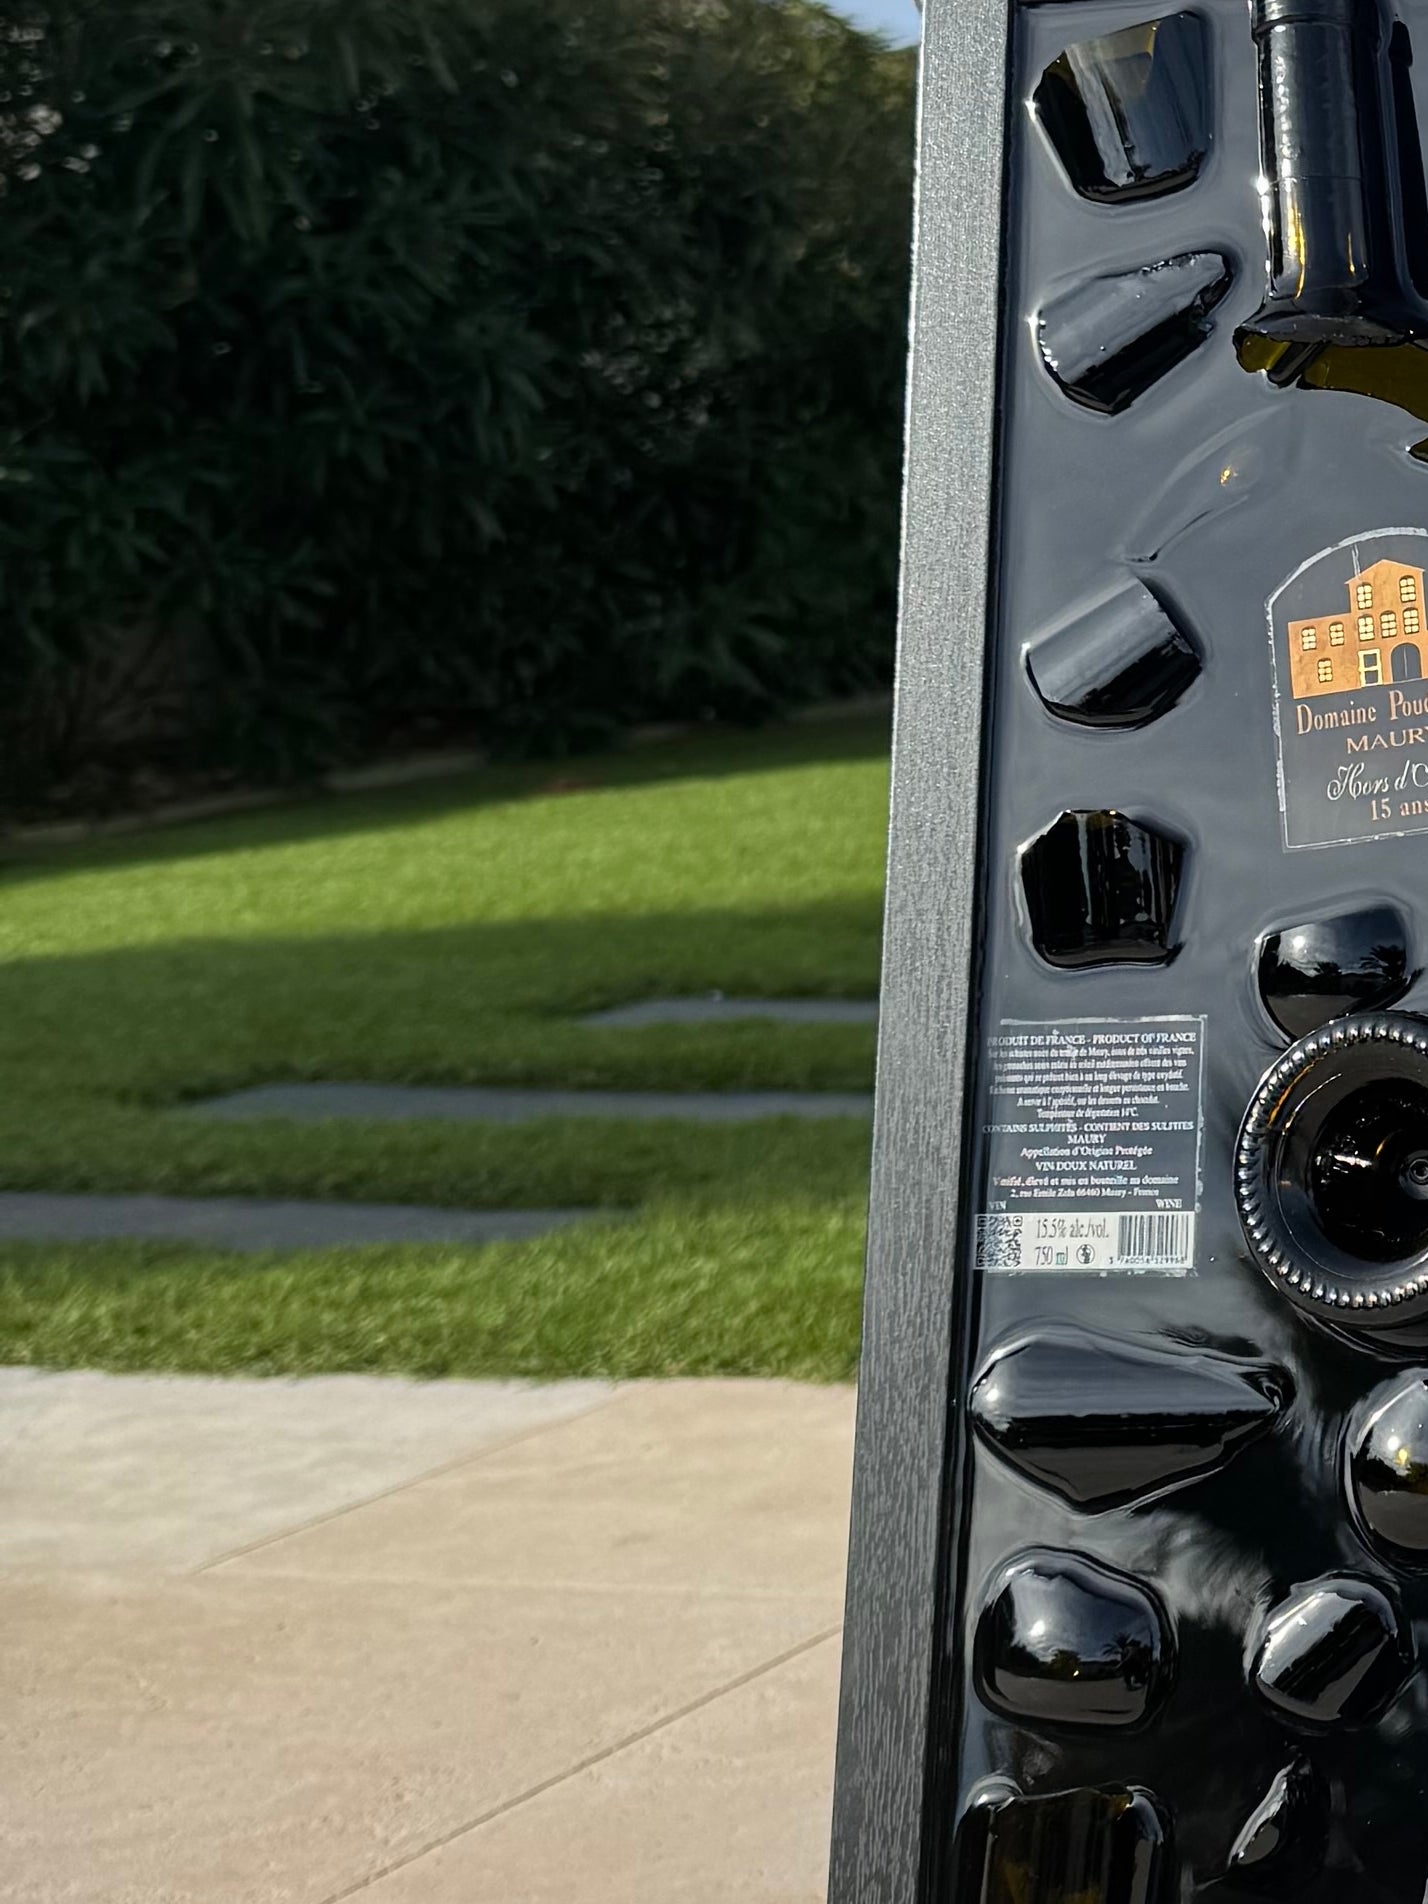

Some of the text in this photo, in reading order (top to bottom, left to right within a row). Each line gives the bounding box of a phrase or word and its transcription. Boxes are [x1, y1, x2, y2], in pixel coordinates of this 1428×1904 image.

[1296, 701, 1377, 735] Domaine
[1327, 763, 1389, 801] Hors
[1371, 799, 1392, 821] 15
[1031, 1035, 1044, 1045] DE
[1046, 1034, 1085, 1045] FRANCE
[1093, 1034, 1140, 1044] PRODUCT
[1156, 1032, 1196, 1042] FRANCE
[1084, 1122, 1130, 1131] CONTIENT
[1132, 1122, 1150, 1131] DES
[1067, 1134, 1106, 1144] MAURY
[1021, 1146, 1070, 1159] Appellation
[1035, 1160, 1137, 1171] VIN DOUX NATUREL
[1156, 1198, 1182, 1208] WINE
[1035, 1246, 1052, 1265] 750
